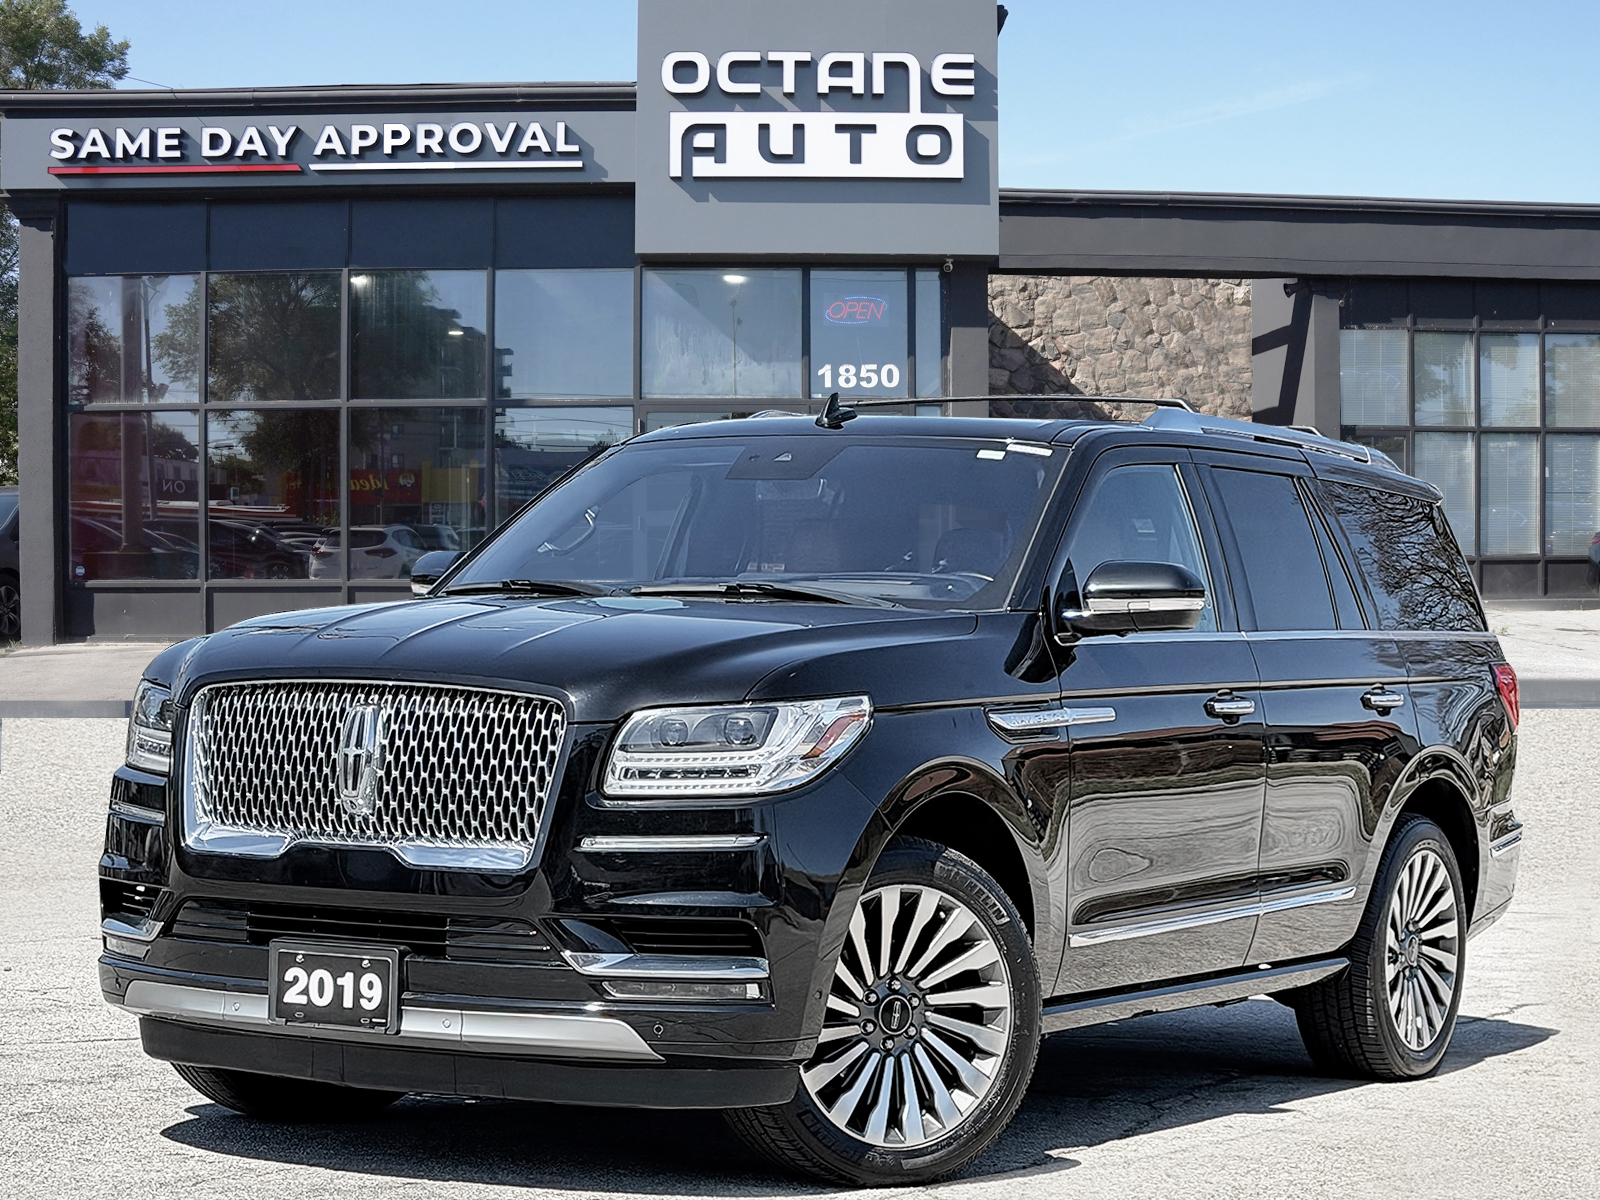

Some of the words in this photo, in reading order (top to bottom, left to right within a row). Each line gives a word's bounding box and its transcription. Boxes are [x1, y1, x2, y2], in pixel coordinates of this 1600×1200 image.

[660, 50, 976, 97] OCTANE
[49, 126, 183, 161] SAME
[199, 124, 300, 159] DAY
[312, 120, 581, 157] APPROVAL
[679, 121, 954, 177] AUTO
[828, 301, 884, 320] OPEN
[817, 363, 900, 389] 1850
[282, 966, 384, 1011] 2019
